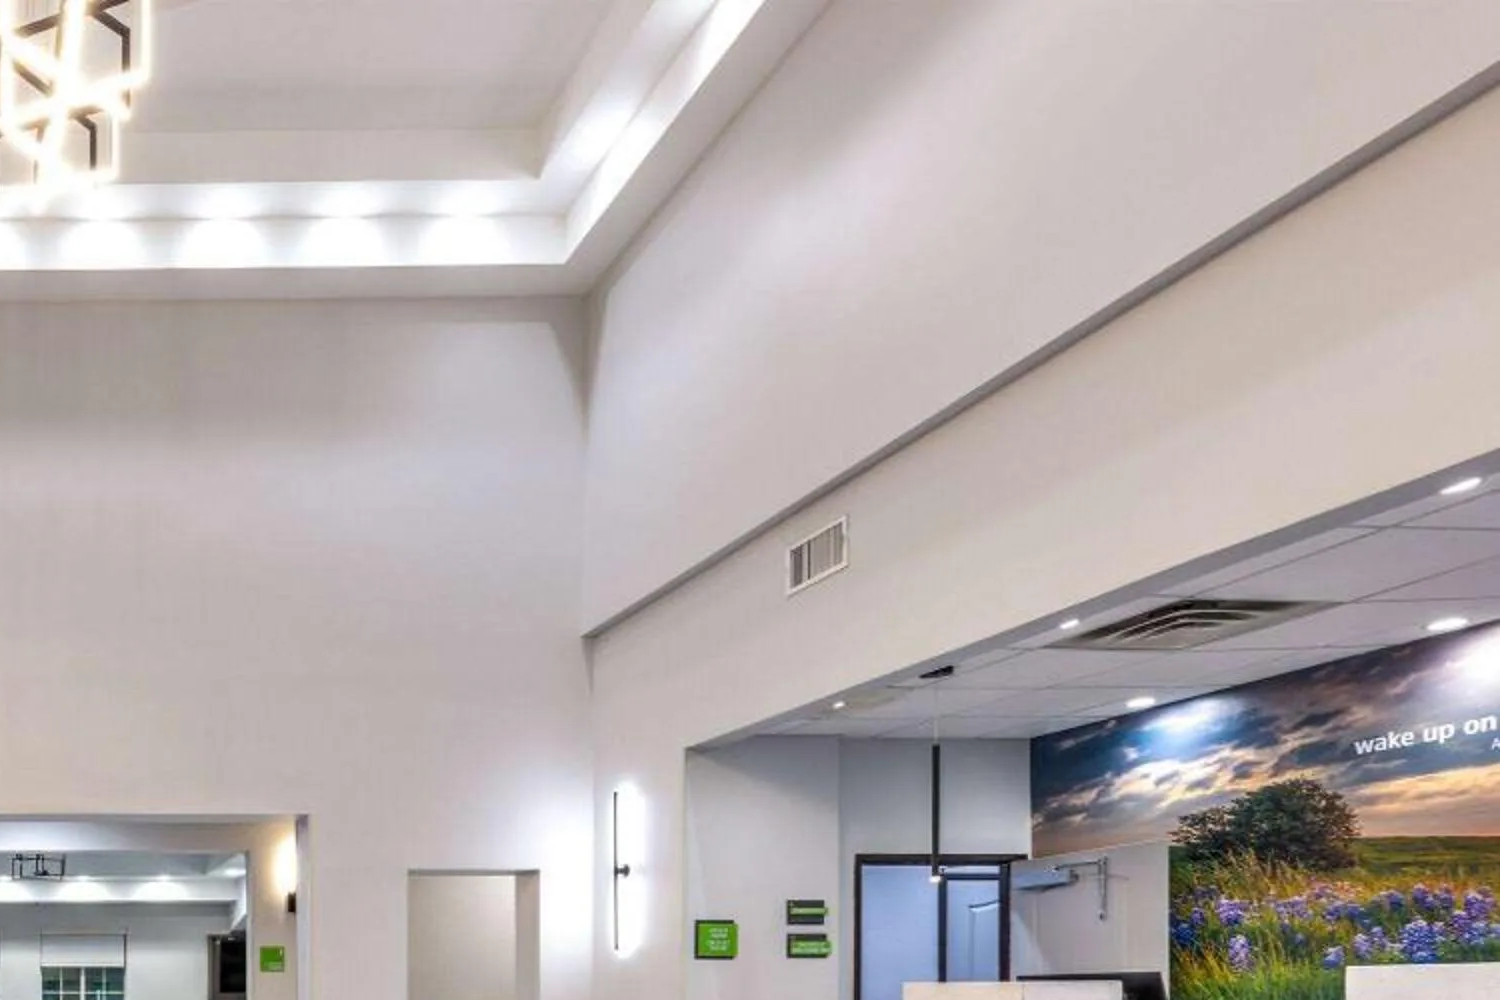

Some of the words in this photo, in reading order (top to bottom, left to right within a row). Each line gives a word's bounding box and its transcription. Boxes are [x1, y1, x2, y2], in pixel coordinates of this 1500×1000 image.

[1354, 731, 1414, 755] wake
[1423, 723, 1455, 744] up
[1463, 715, 1497, 735] on
